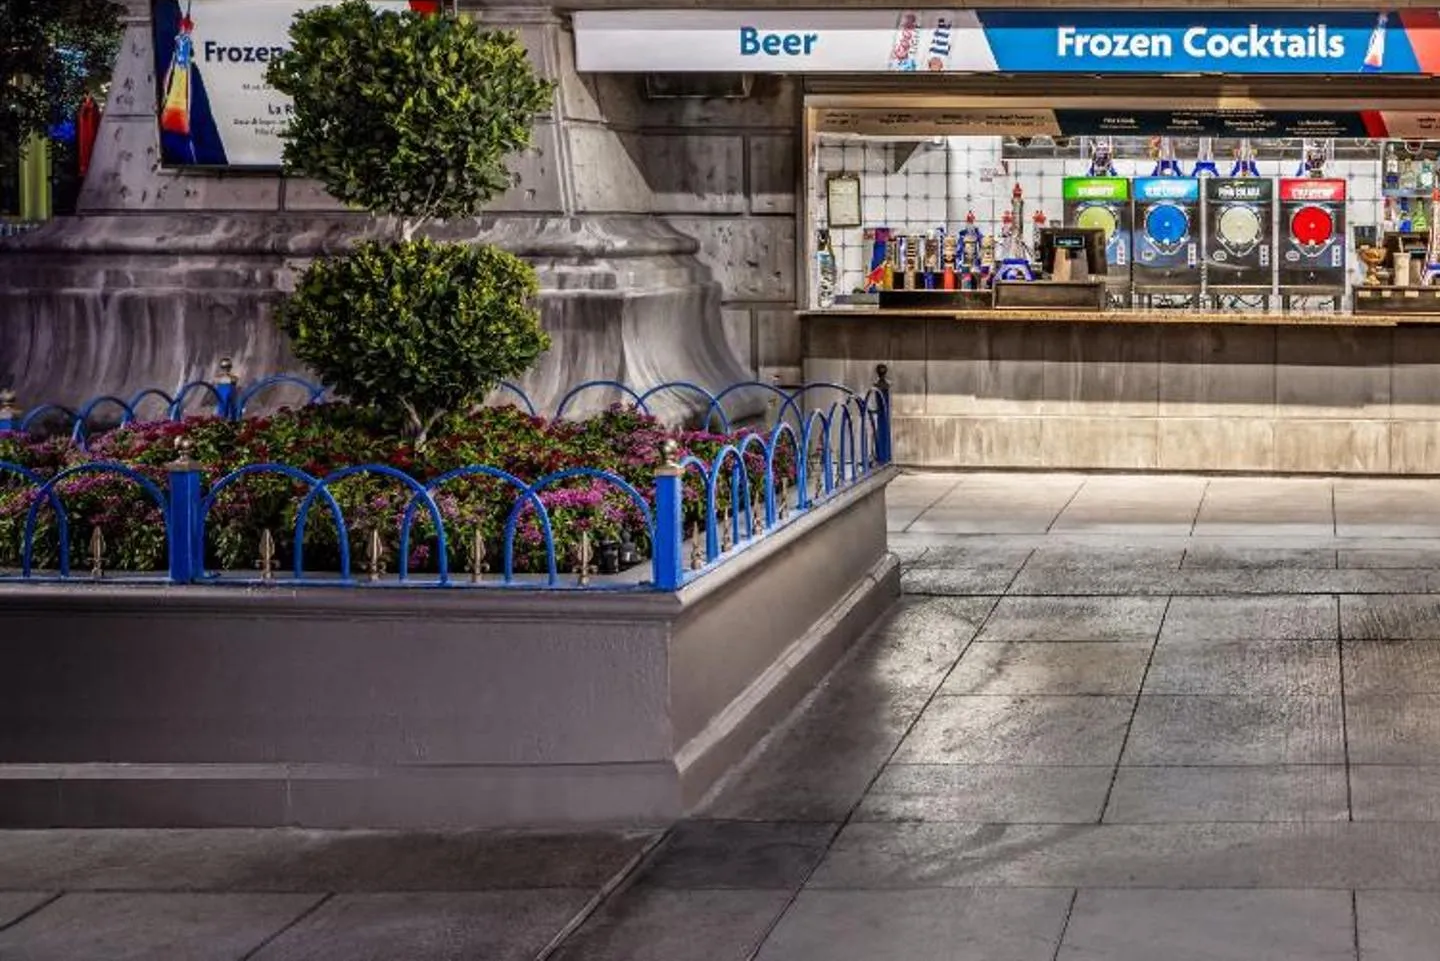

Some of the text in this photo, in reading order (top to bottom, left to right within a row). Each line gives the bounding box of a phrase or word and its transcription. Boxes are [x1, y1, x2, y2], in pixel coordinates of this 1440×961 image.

[740, 26, 818, 56] Beer
[1057, 24, 1345, 58] Frozen Cocktails
[268, 102, 281, 115] La
